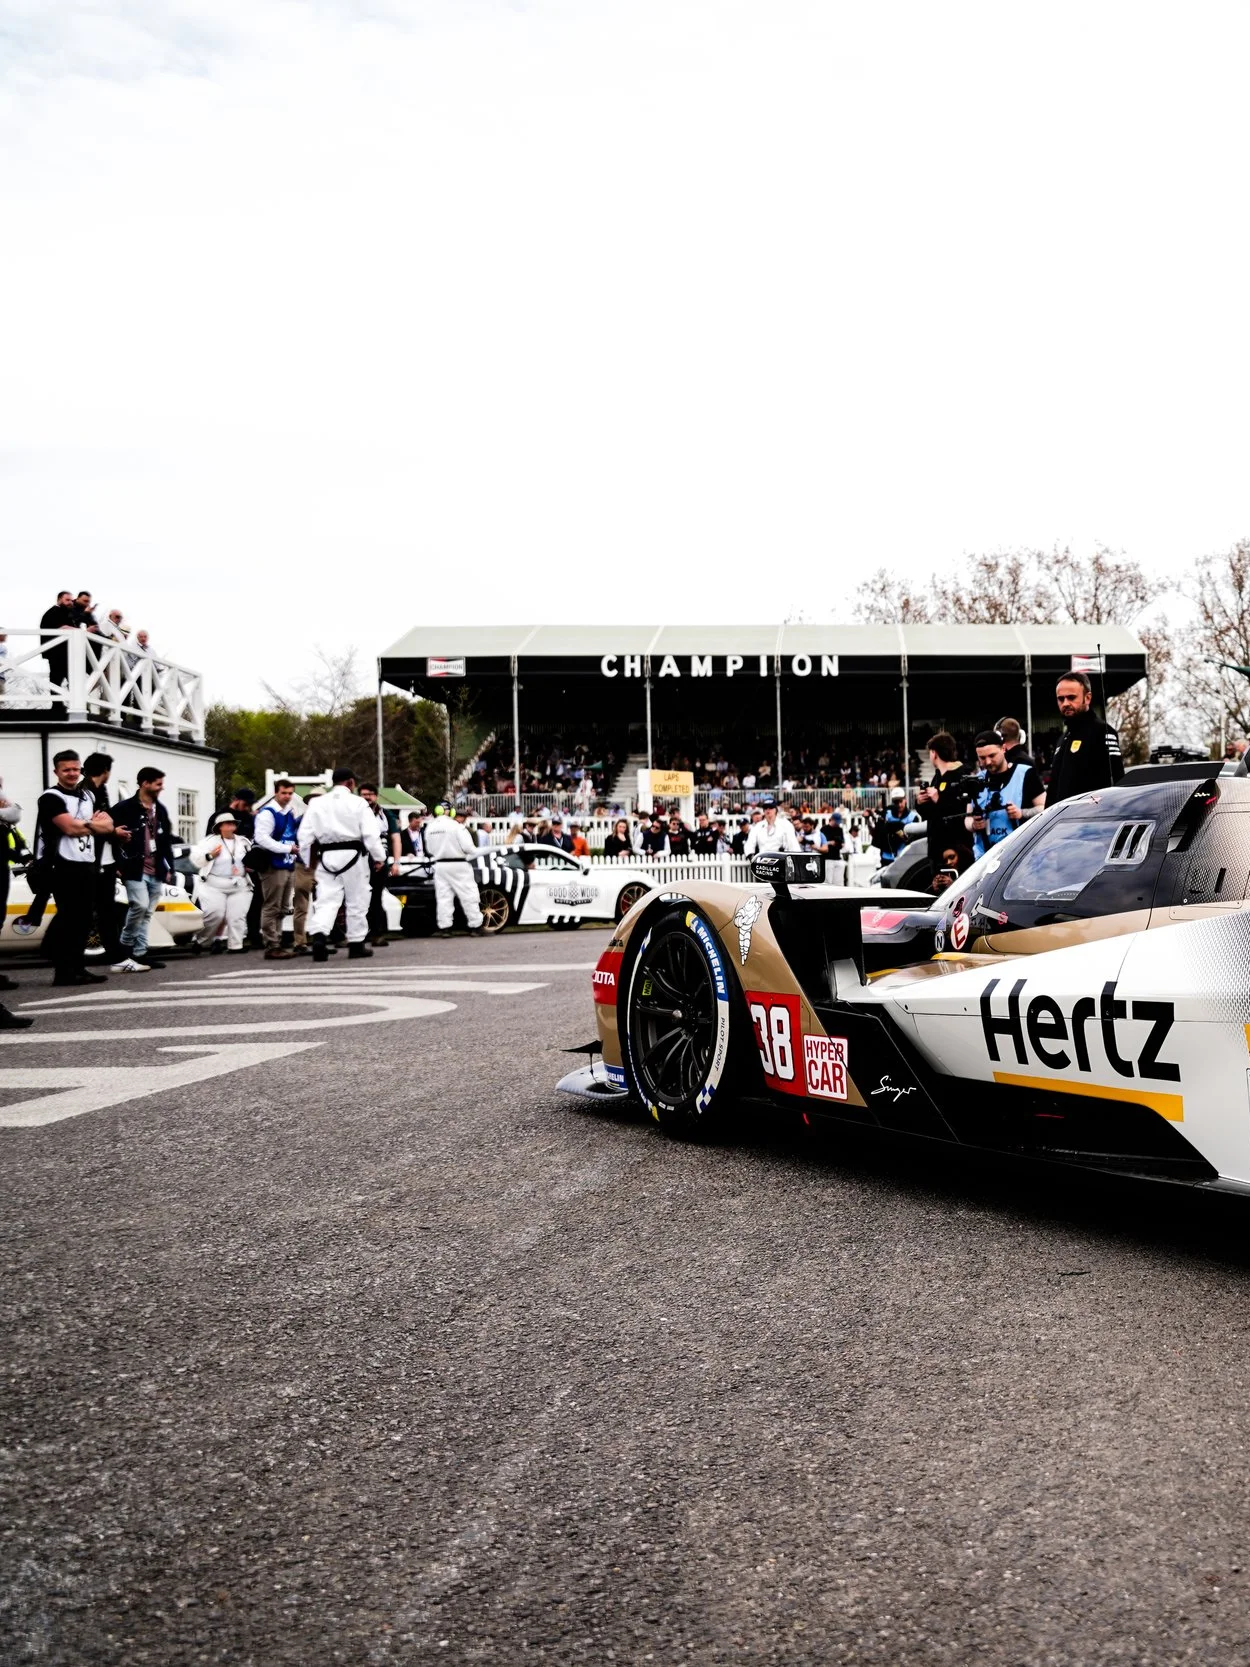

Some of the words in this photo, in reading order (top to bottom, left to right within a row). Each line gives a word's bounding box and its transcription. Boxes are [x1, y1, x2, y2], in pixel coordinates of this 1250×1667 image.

[600, 653, 839, 678] CHAMPION
[653, 783, 690, 793] COMPLETED
[664, 773, 680, 782] LAPS
[954, 916, 966, 949] E
[696, 926, 726, 995] MICHELIN
[750, 1004, 795, 1080] 38
[979, 978, 1182, 1083] Hertz
[715, 1043, 725, 1072] SPORT
[805, 1039, 844, 1062] HYPER
[807, 1059, 845, 1095] CAR
